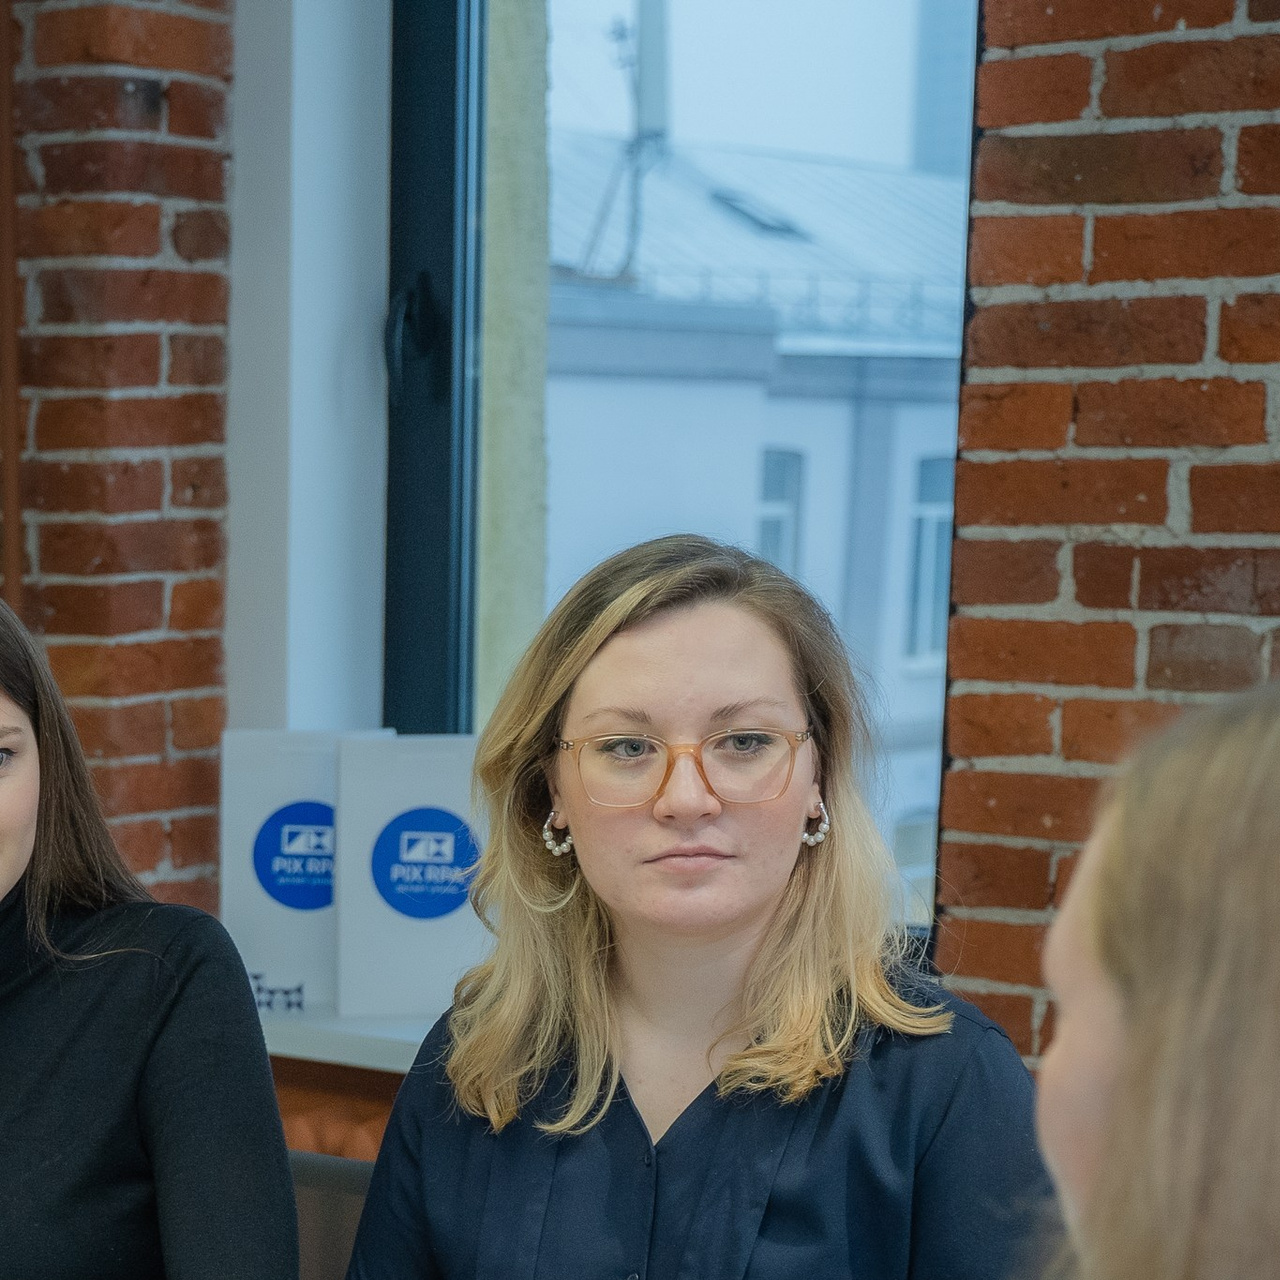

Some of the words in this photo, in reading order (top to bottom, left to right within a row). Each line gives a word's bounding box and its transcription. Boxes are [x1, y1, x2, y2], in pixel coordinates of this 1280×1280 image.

[271, 856, 304, 874] PIX
[305, 857, 333, 874] RP
[390, 863, 423, 882] PIX
